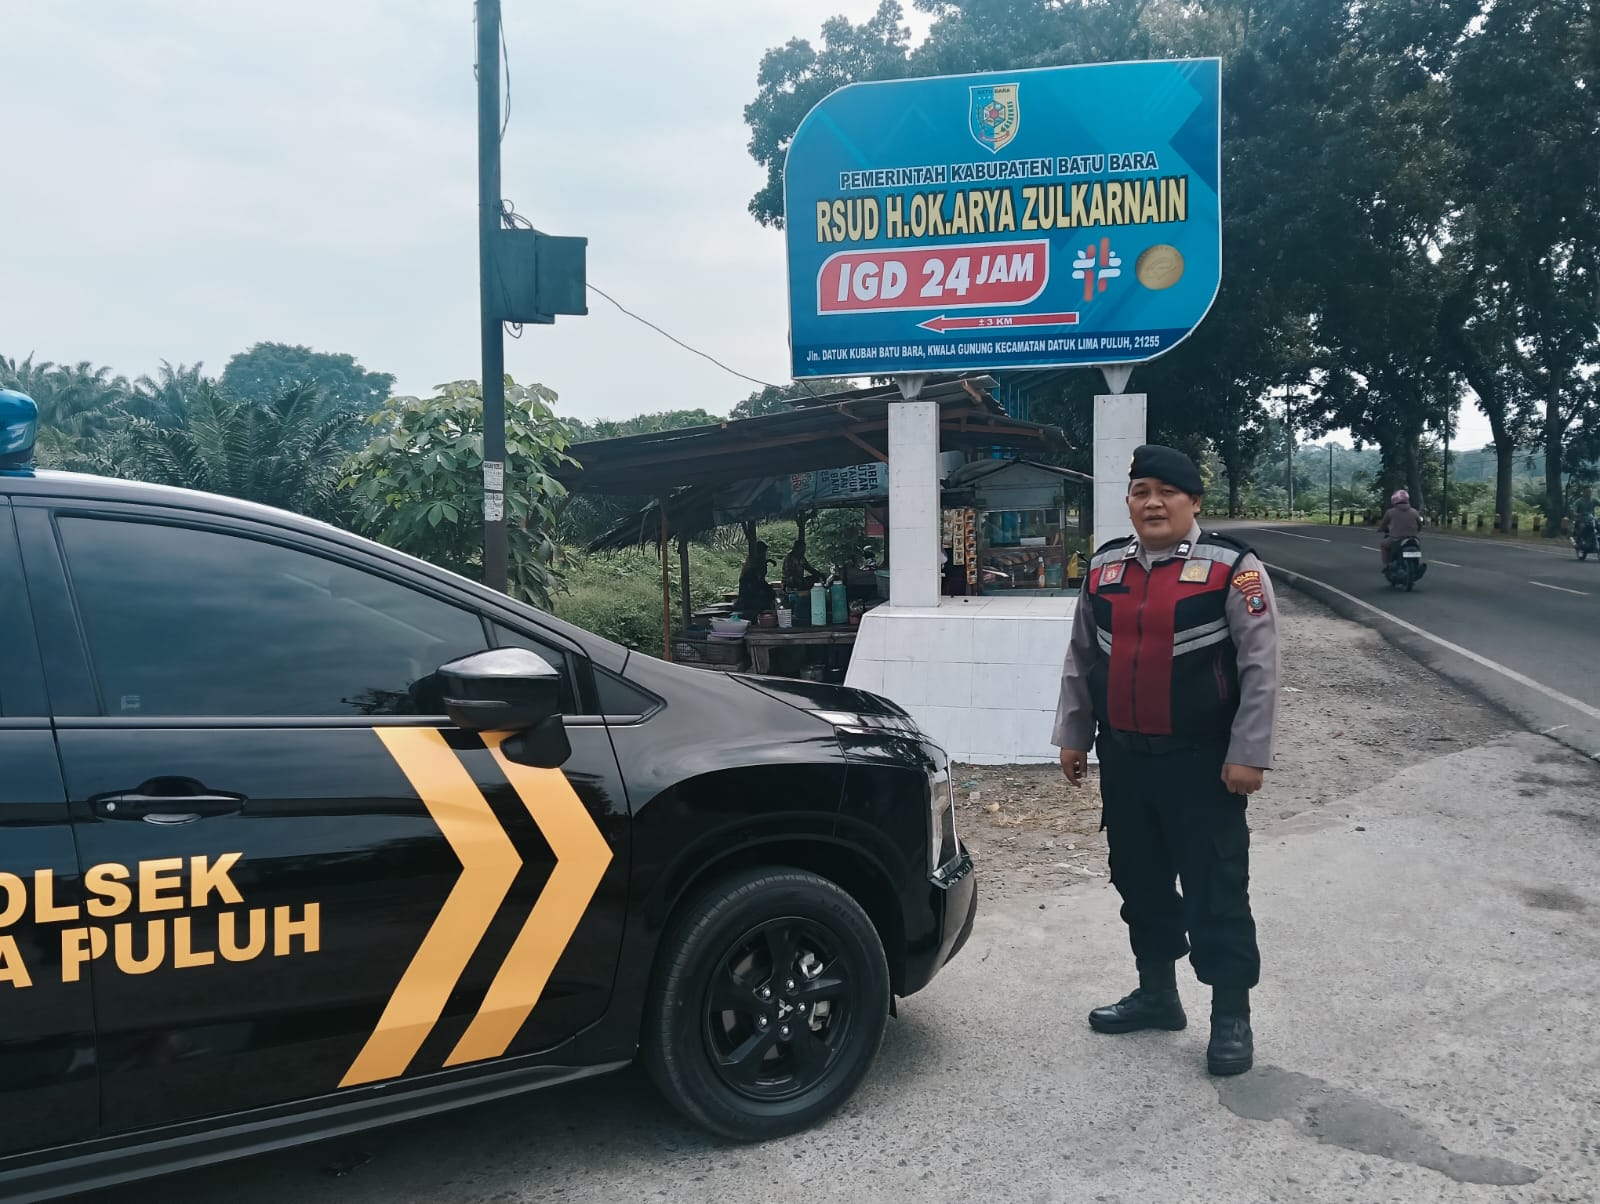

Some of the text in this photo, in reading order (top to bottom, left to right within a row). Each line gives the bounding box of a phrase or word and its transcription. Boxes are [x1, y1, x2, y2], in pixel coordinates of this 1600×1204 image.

[840, 151, 1159, 190] PEMERINTAH KABUPATEN BATU BARA
[816, 176, 1188, 243] RSUD H.OK.ARYA ZULKARNAIN
[837, 252, 1034, 302] IGD 24 JAM
[996, 317, 1013, 325] KM
[822, 348, 849, 361] DATUK
[849, 347, 878, 359] KUBAH
[879, 346, 900, 358] BATU
[902, 345, 926, 359] BARA,
[927, 343, 956, 356] KWALA
[957, 342, 993, 355] GUNUNG
[995, 340, 1046, 353] KECAMATAN
[1047, 338, 1076, 351] DATUK
[1078, 337, 1099, 350] LIMA
[1100, 336, 1132, 350] PULUH,
[1134, 335, 1160, 348] 21255
[867, 464, 879, 491] AREA
[61, 902, 320, 983] PULUH
